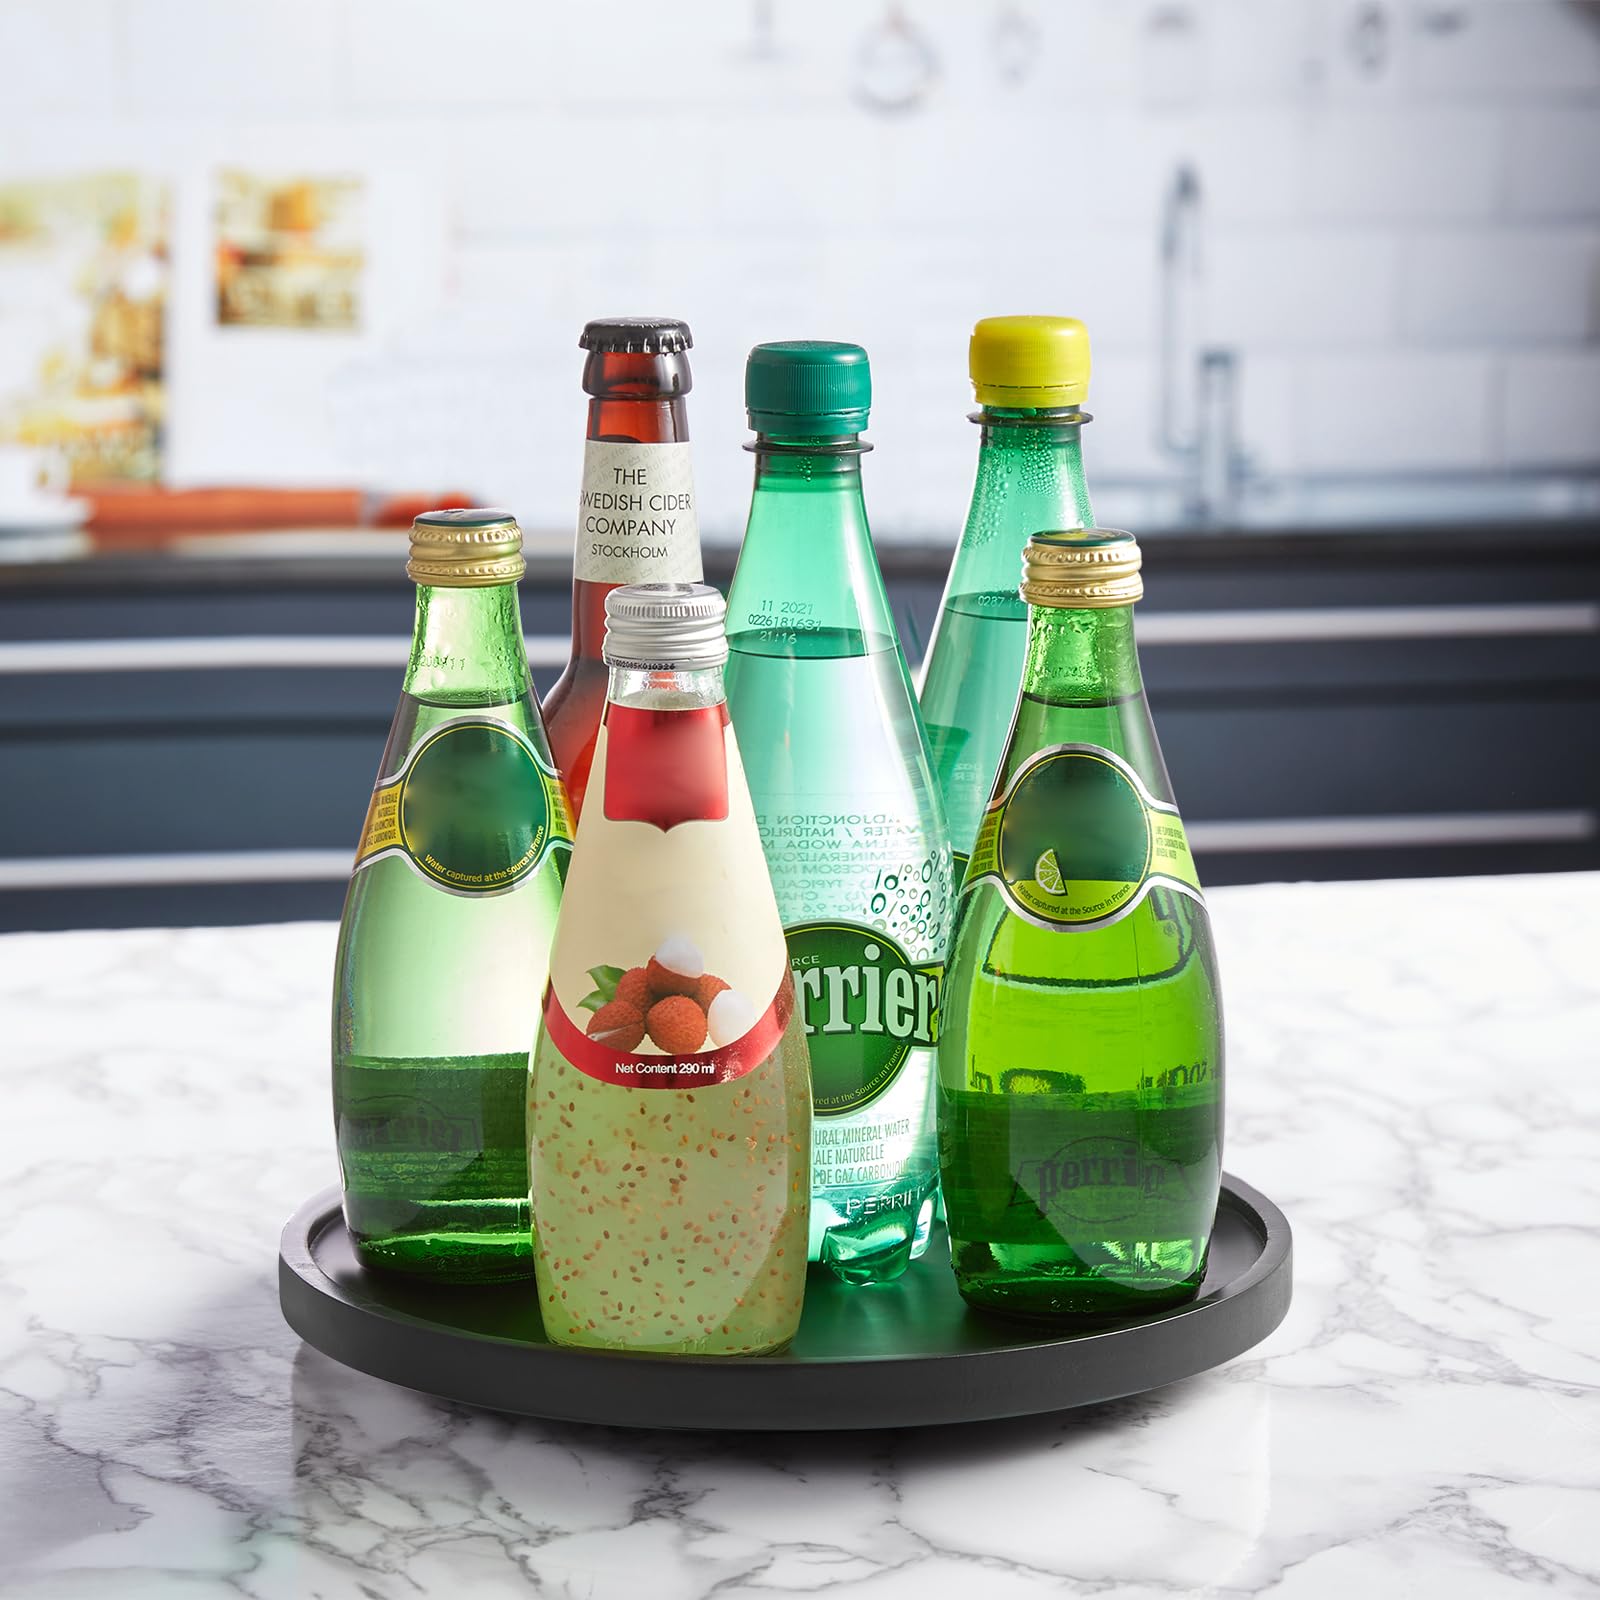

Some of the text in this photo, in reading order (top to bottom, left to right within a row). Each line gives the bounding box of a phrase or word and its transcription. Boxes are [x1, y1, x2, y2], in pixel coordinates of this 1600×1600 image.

[613, 467, 647, 485] THE
[649, 494, 691, 511] CIDER
[585, 516, 676, 536] COMPANY
[591, 543, 668, 559] STOCKHOLM
[762, 600, 814, 615] 11 2021
[424, 825, 545, 883] Water captured at the Source in France
[1017, 882, 1131, 915] Water captured at the Source in France
[615, 1062, 715, 1074] Net Content 290 ml
[831, 1094, 841, 1105] at
[841, 1091, 855, 1102] the
[855, 1075, 880, 1097] Source
[879, 1069, 888, 1079] in
[885, 1044, 902, 1071] France
[842, 1124, 883, 1144] MINERAL
[884, 1118, 910, 1137] WATER
[813, 1143, 885, 1166] ALE NATURELLE
[835, 1167, 855, 1184] GAZ
